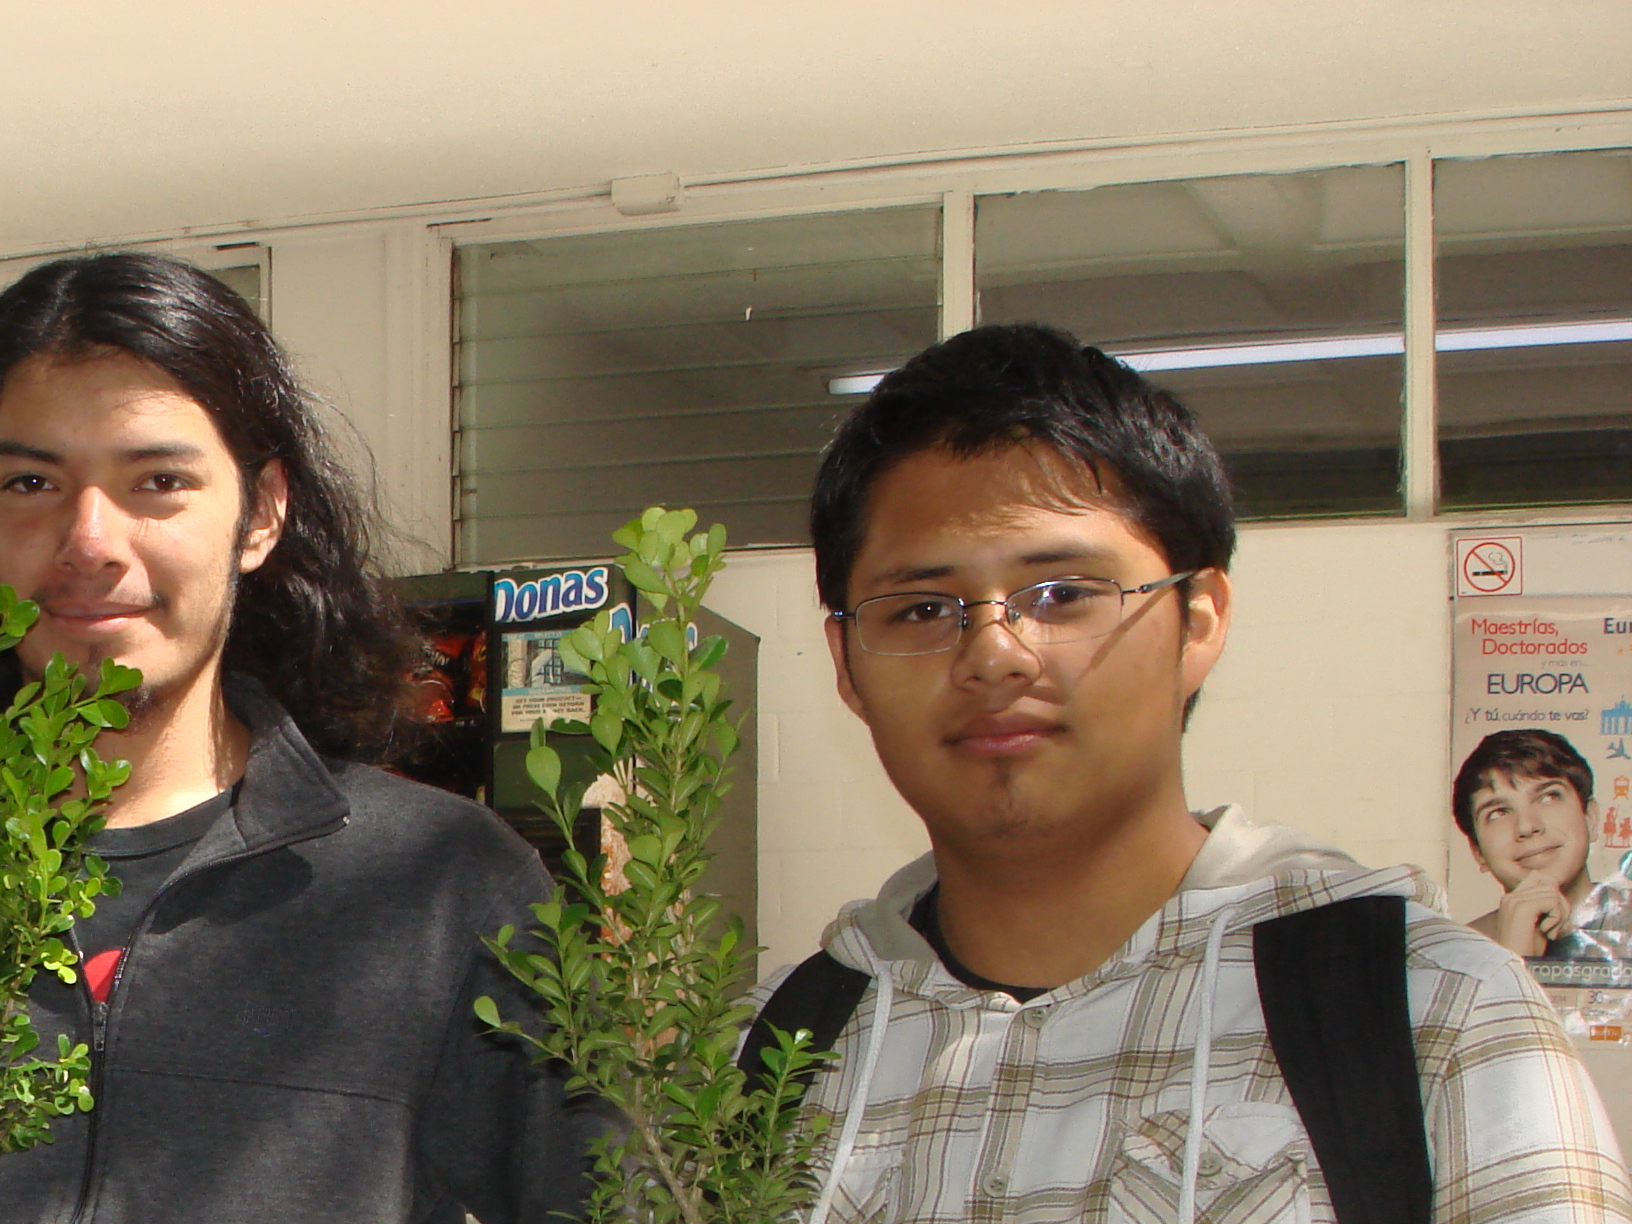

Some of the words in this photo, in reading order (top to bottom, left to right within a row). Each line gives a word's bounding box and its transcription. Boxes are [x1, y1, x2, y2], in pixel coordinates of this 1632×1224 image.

[494, 566, 610, 623] Donas
[1471, 618, 1559, 637] Maestrías,
[1482, 638, 1588, 655] Doctorados
[1486, 672, 1589, 695] EUROPA
[1548, 710, 1561, 721] te
[1564, 708, 1589, 721] vas?
